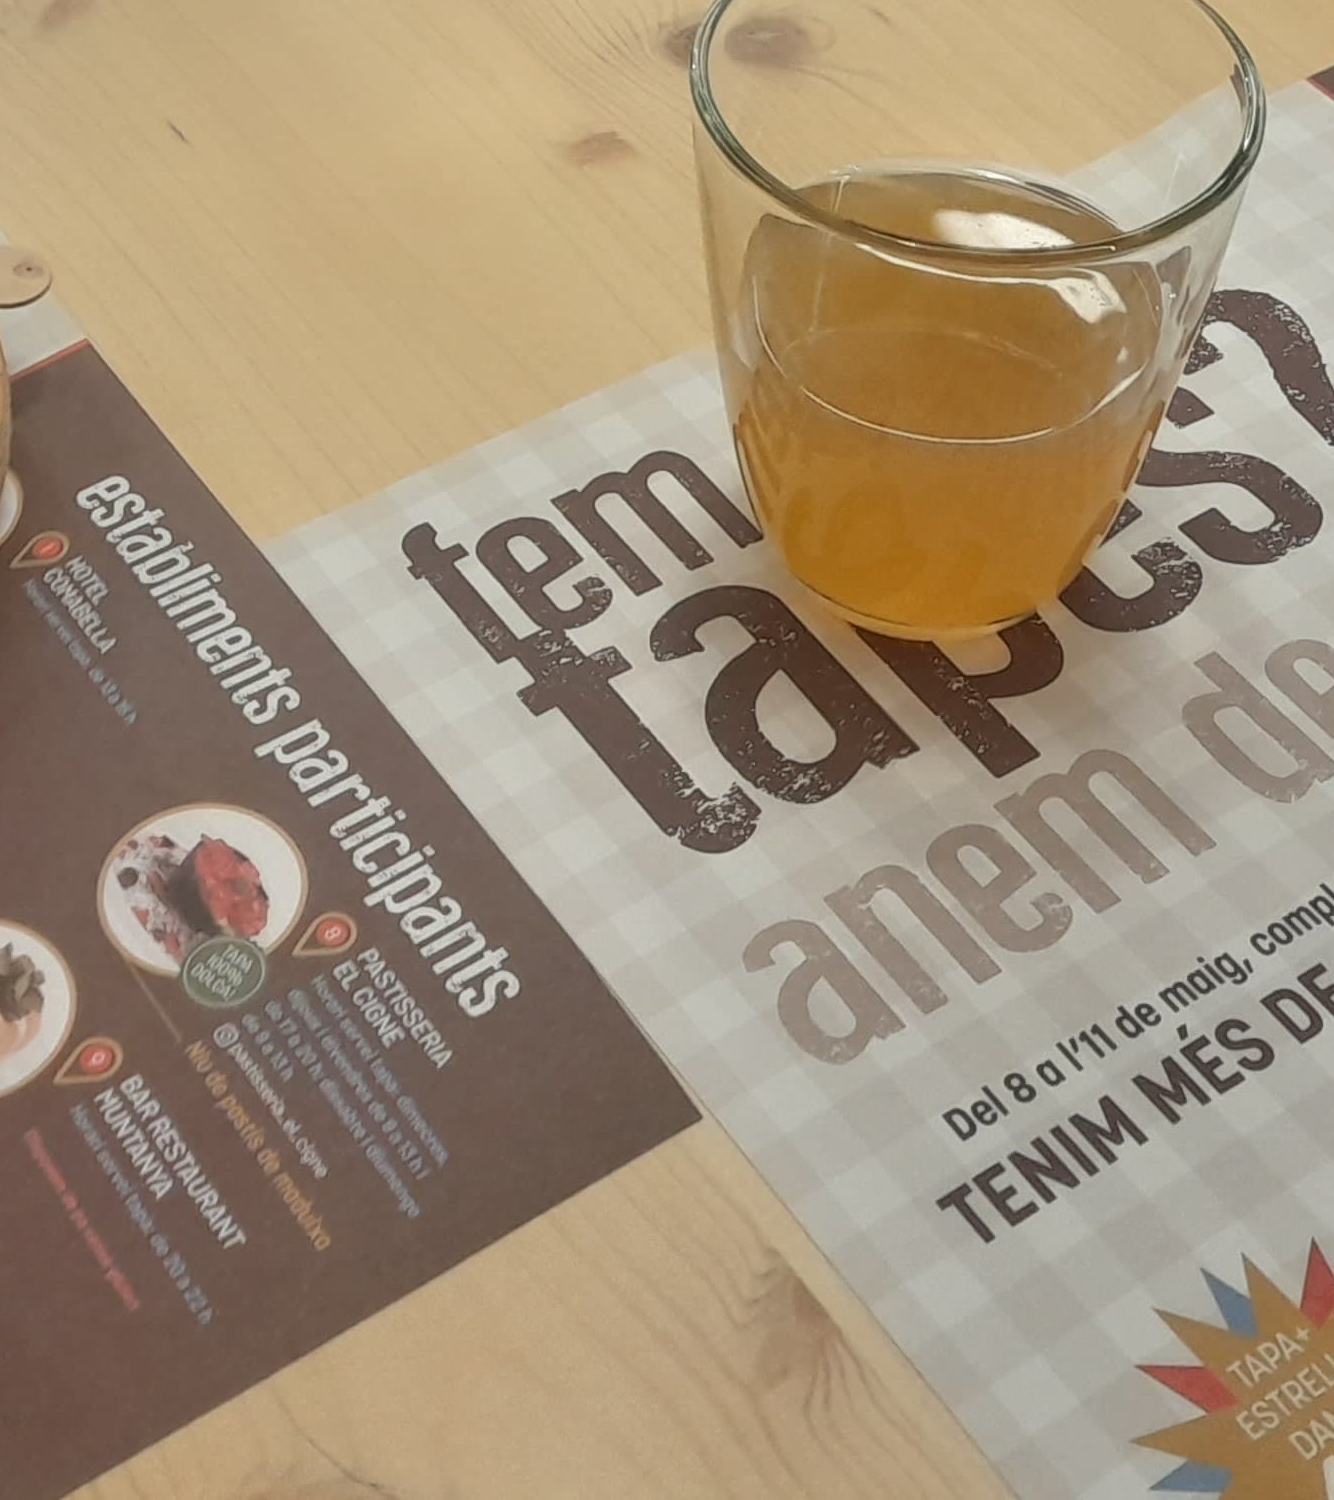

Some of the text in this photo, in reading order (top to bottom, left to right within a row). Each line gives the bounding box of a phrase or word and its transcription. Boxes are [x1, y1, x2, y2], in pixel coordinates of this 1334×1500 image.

[62, 555, 115, 606] HOTEL
[400, 445, 770, 664] fem
[71, 473, 309, 726] establiments
[256, 718, 527, 1019] participants
[715, 738, 1220, 1077] anem
[329, 959, 409, 1048] EL CIGNE
[352, 946, 460, 1070] PASTISSERIA
[938, 1084, 1014, 1144] Del
[998, 1068, 1042, 1107] 8
[1032, 1057, 1069, 1089] a
[1105, 993, 1166, 1041] de
[1149, 939, 1260, 1019] maig,
[89, 1087, 179, 1201] MUNTANYA
[116, 1073, 251, 1253] BAR RESTAURANT
[933, 1093, 1150, 1250] TENIM
[1116, 998, 1282, 1125] MÉS
[1225, 1318, 1318, 1392] TAPA+
